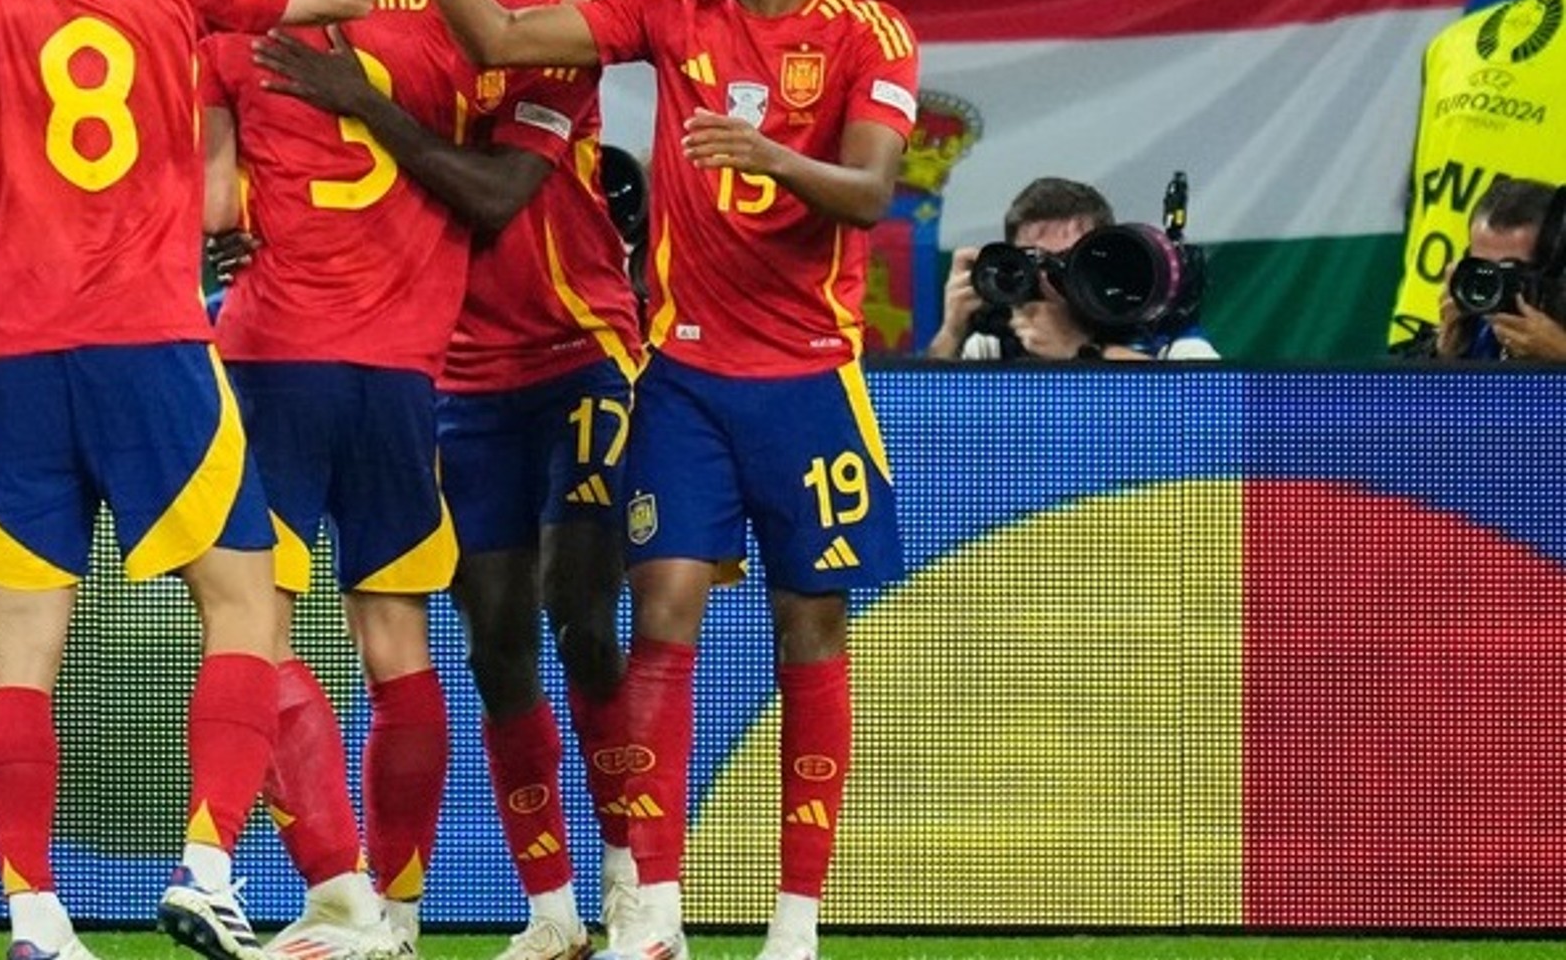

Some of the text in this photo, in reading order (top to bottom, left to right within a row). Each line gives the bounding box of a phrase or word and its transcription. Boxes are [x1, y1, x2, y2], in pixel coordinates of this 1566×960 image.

[40, 15, 139, 193] 8
[1435, 92, 1548, 124] EURO2024
[568, 397, 630, 467] 17
[803, 441, 870, 529] 19
